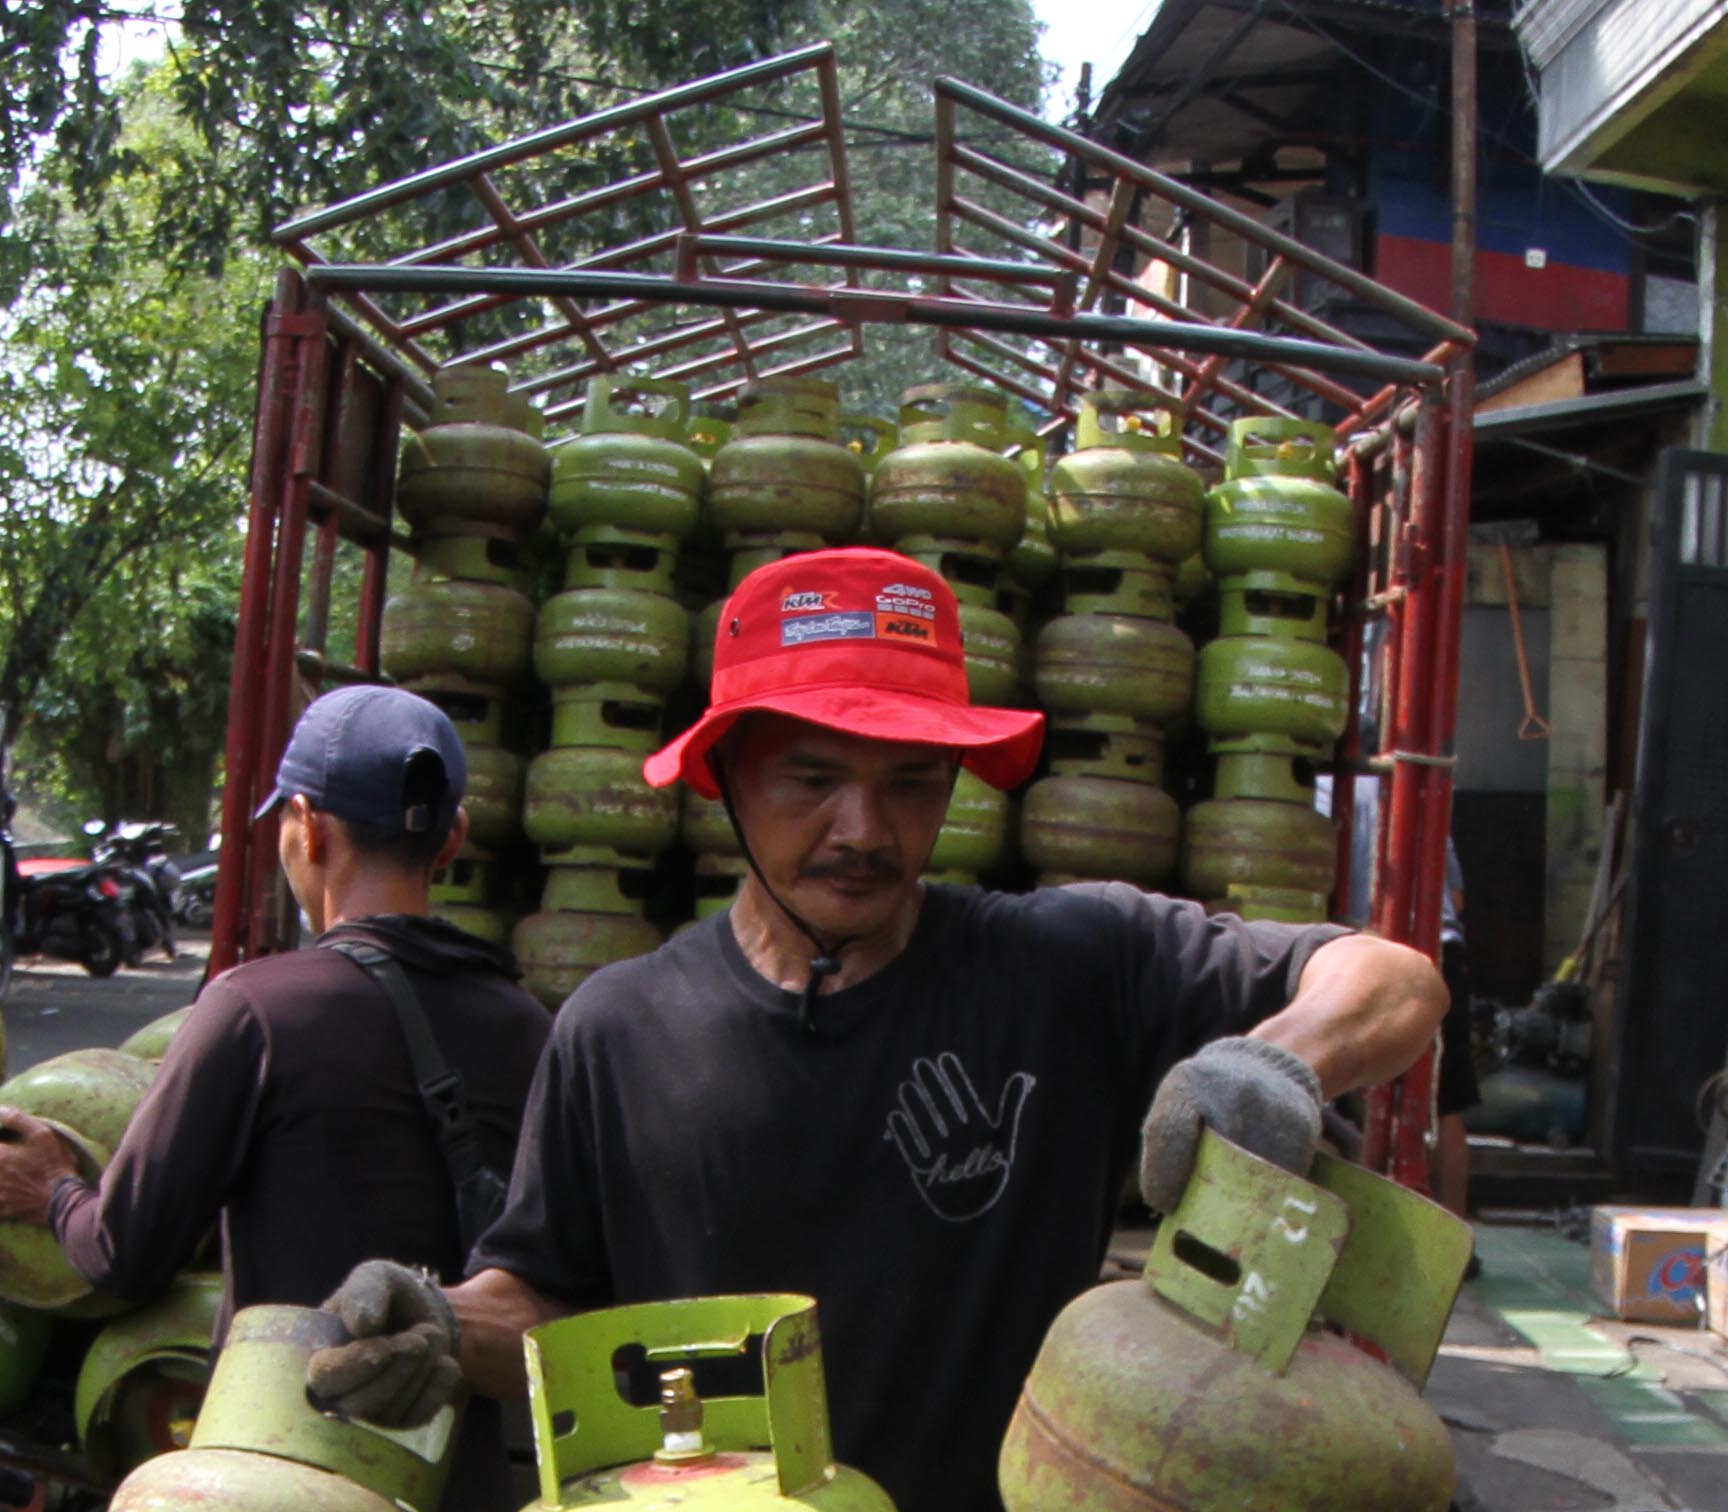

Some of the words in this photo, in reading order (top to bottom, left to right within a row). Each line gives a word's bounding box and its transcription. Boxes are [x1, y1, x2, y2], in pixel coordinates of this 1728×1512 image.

[875, 595, 936, 613] GoPro
[885, 621, 929, 638] KTM
[926, 1144, 1007, 1187] hello
